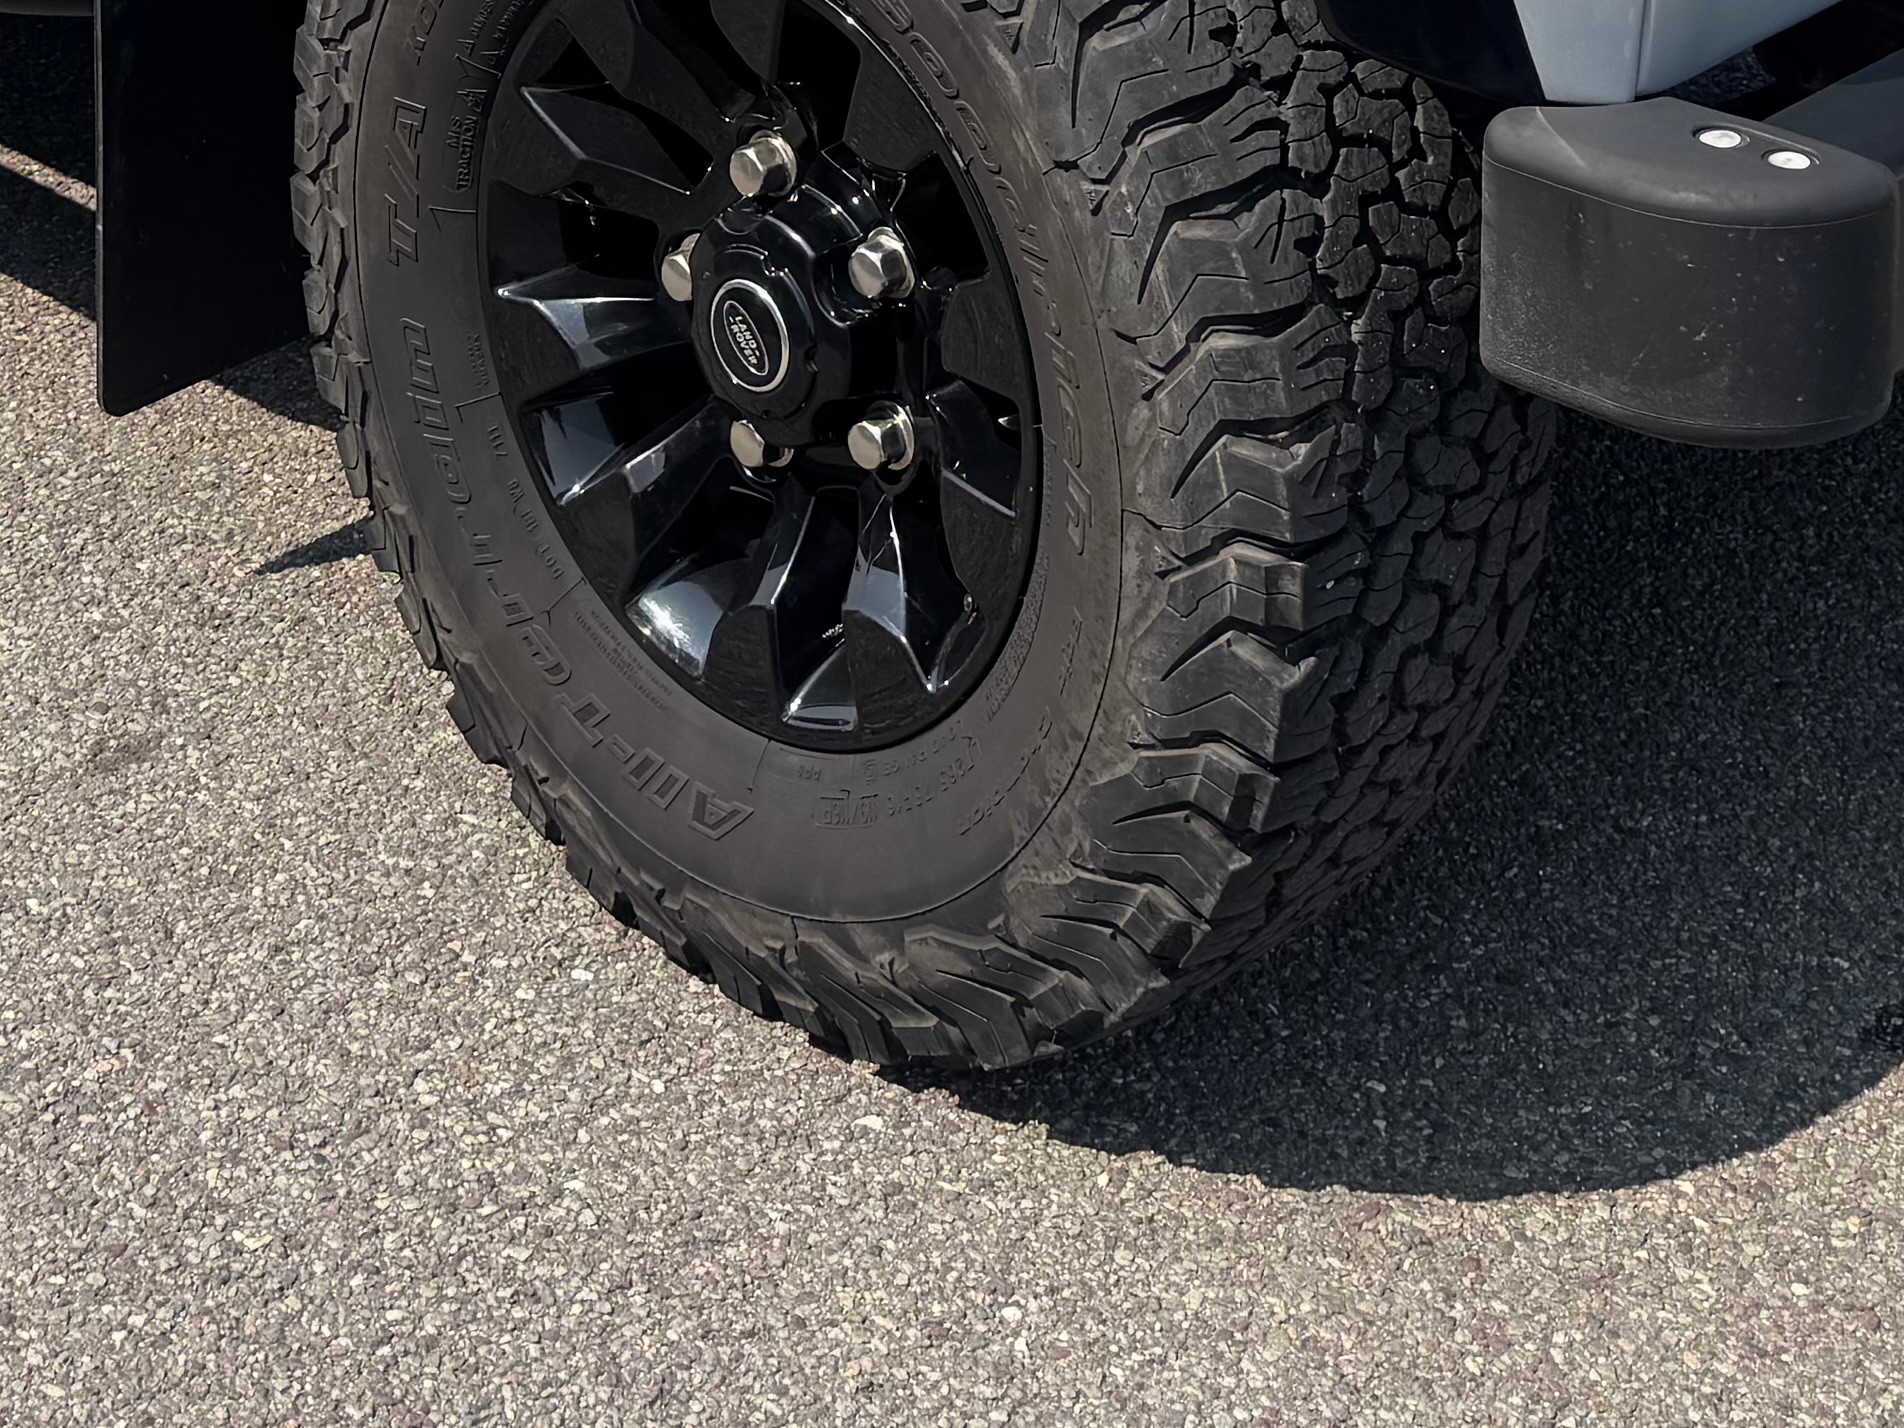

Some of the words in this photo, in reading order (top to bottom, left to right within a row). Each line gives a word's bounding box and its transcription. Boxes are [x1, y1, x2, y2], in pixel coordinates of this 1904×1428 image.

[386, 96, 428, 268] T/A
[730, 323, 758, 365] ROVER
[735, 315, 758, 350] LAND
[398, 317, 754, 841] All-Terrain
